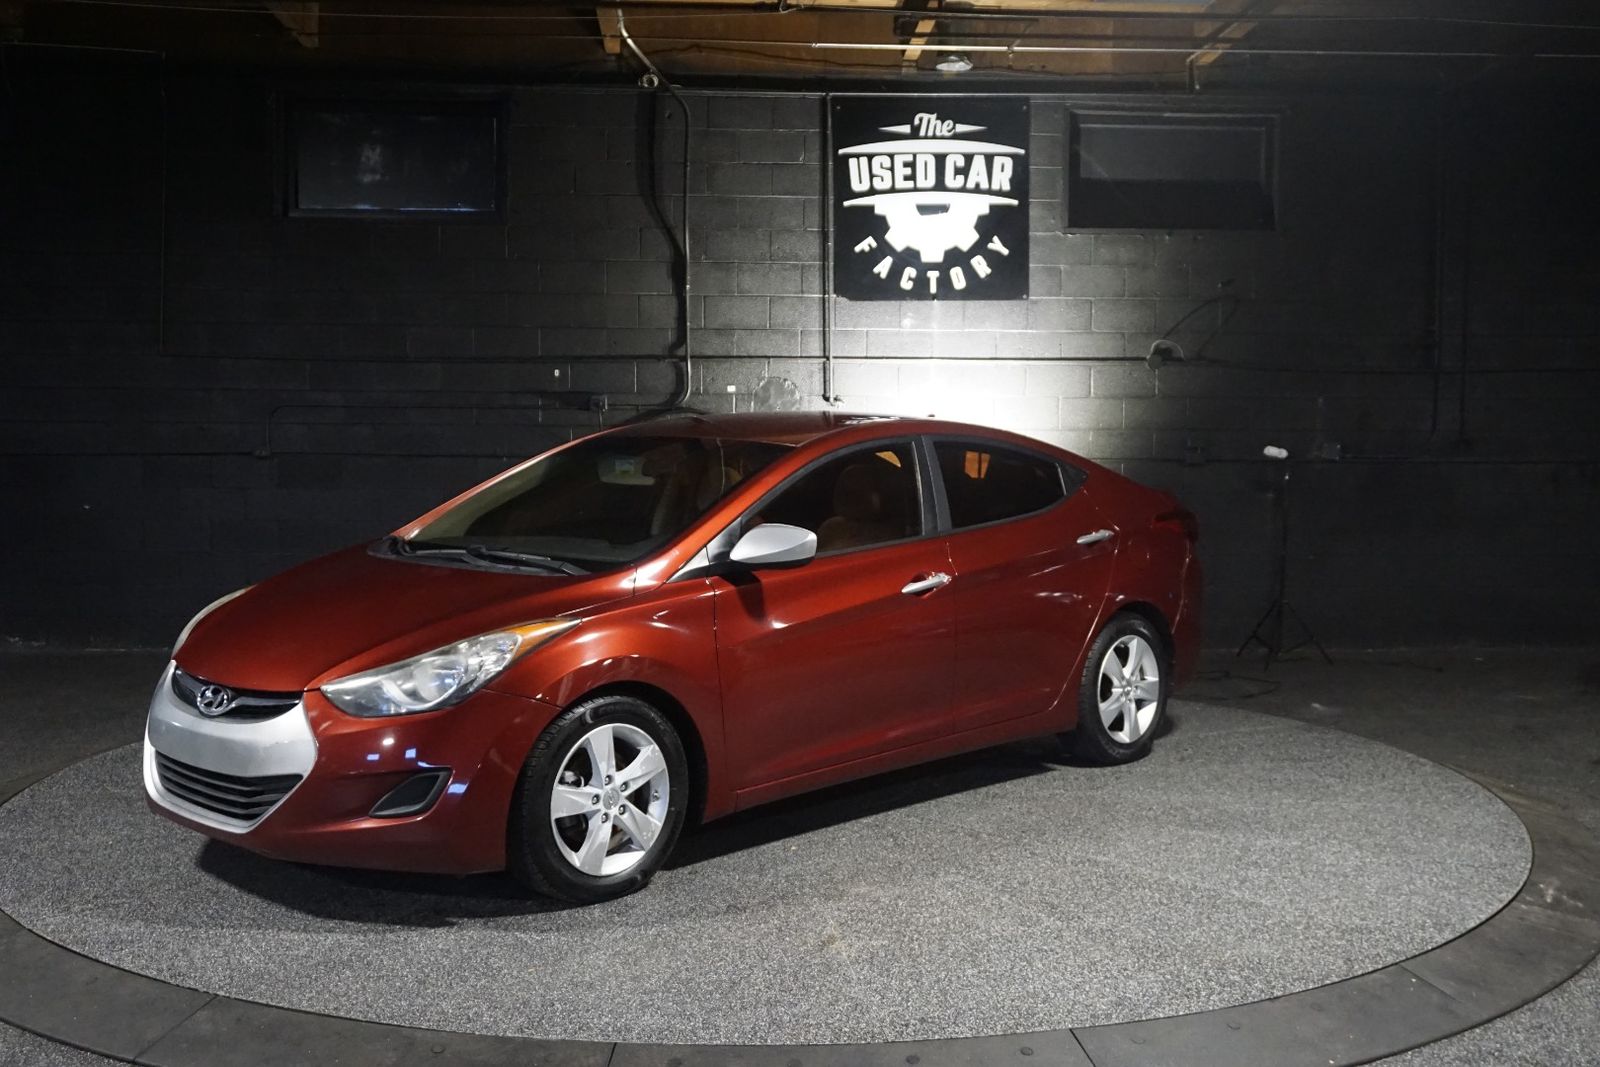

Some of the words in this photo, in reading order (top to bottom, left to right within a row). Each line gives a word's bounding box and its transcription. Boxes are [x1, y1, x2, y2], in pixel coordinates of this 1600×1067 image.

[914, 112, 956, 137] The
[849, 153, 936, 193] USED
[944, 153, 1014, 192] CAR
[854, 235, 1010, 294] FACTORY
